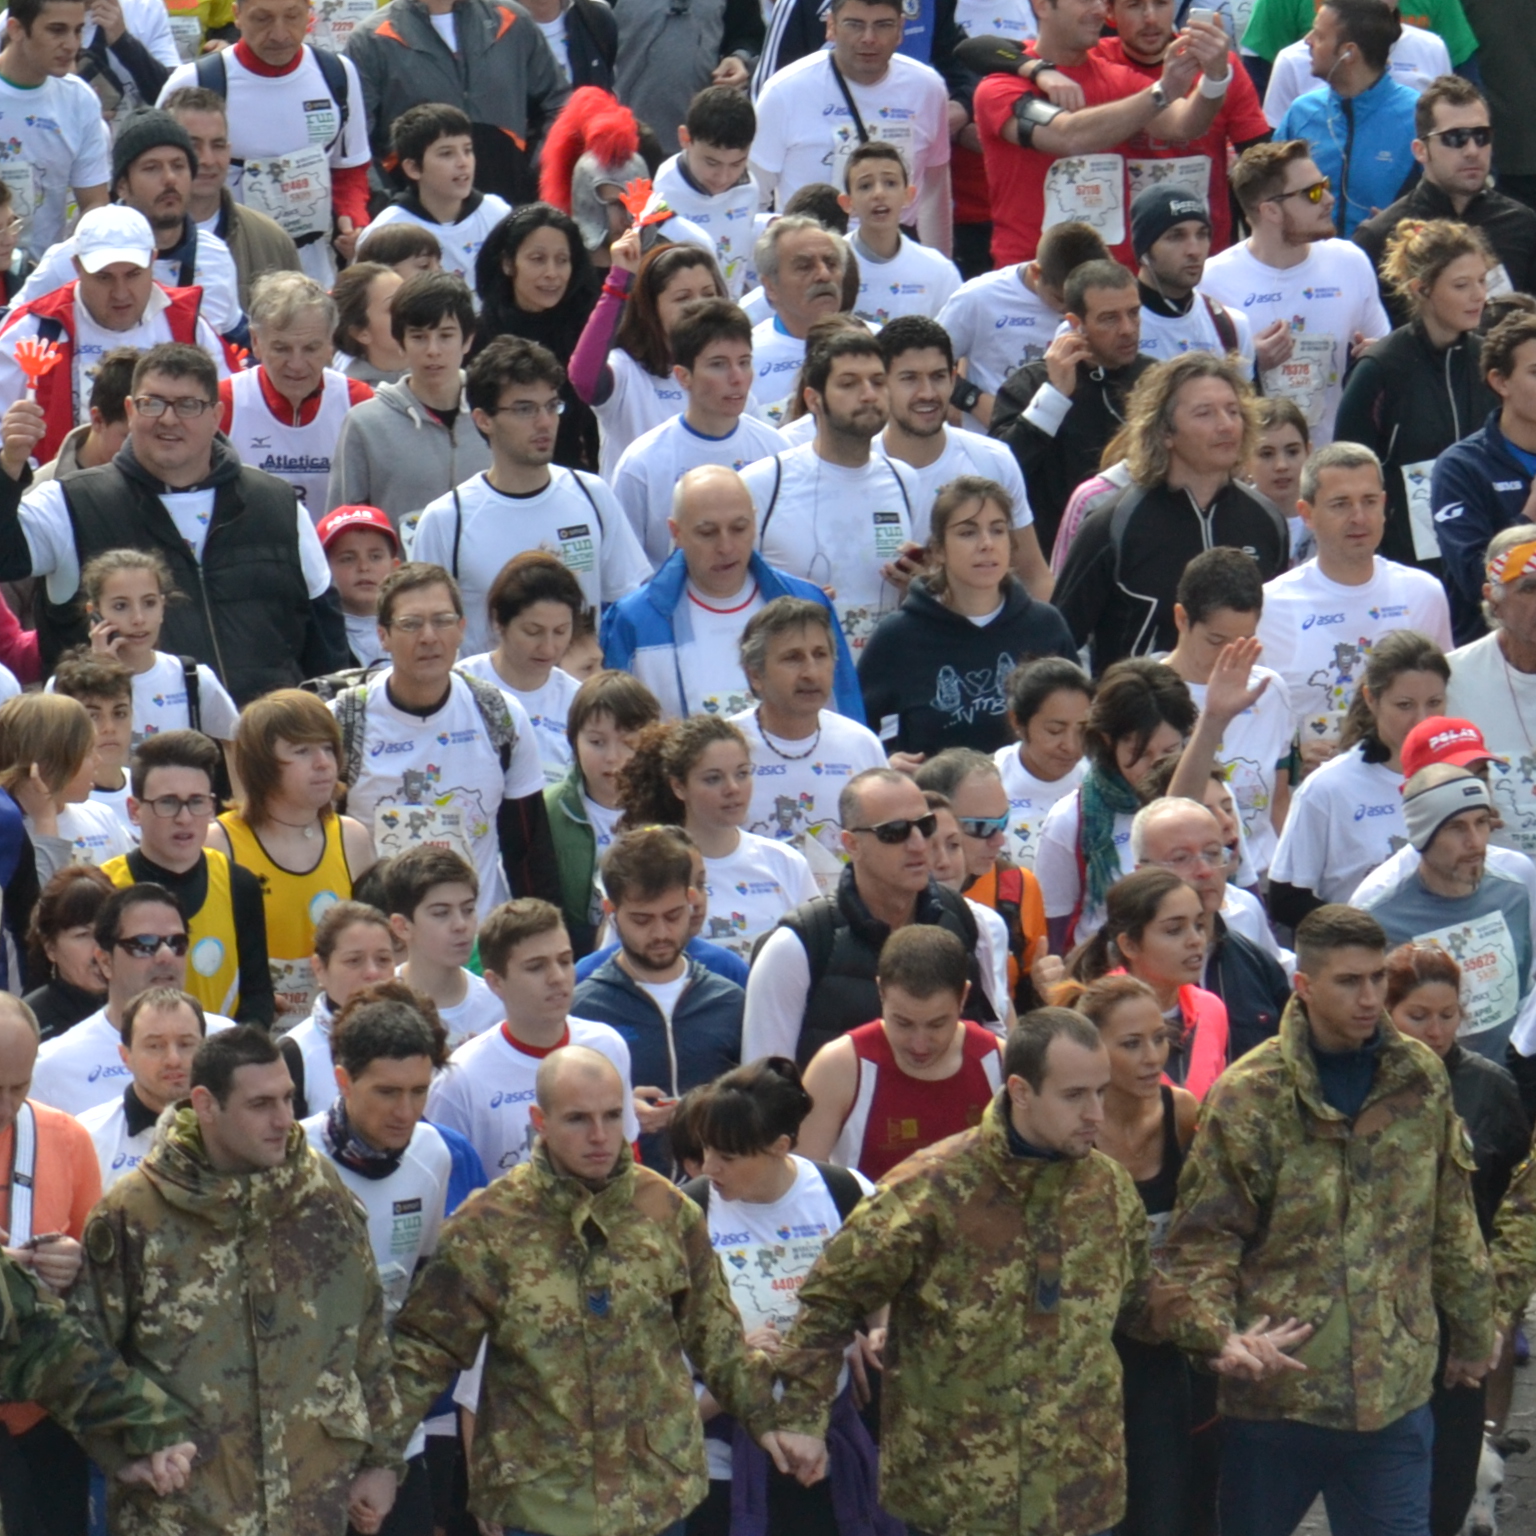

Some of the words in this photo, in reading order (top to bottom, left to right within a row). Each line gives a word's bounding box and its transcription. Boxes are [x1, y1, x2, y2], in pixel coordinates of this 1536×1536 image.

[1257, 292, 1282, 303] asics
[1009, 317, 1036, 326] asics
[265, 454, 329, 467] Atletica
[562, 539, 593, 553] run
[1317, 613, 1345, 626] asics
[385, 740, 414, 754] asics
[757, 764, 786, 775] asics
[1367, 804, 1395, 816] asics
[505, 1089, 535, 1104] asics
[393, 1216, 421, 1230] run
[721, 1232, 750, 1245] asics
[771, 1275, 804, 1290] 4409
